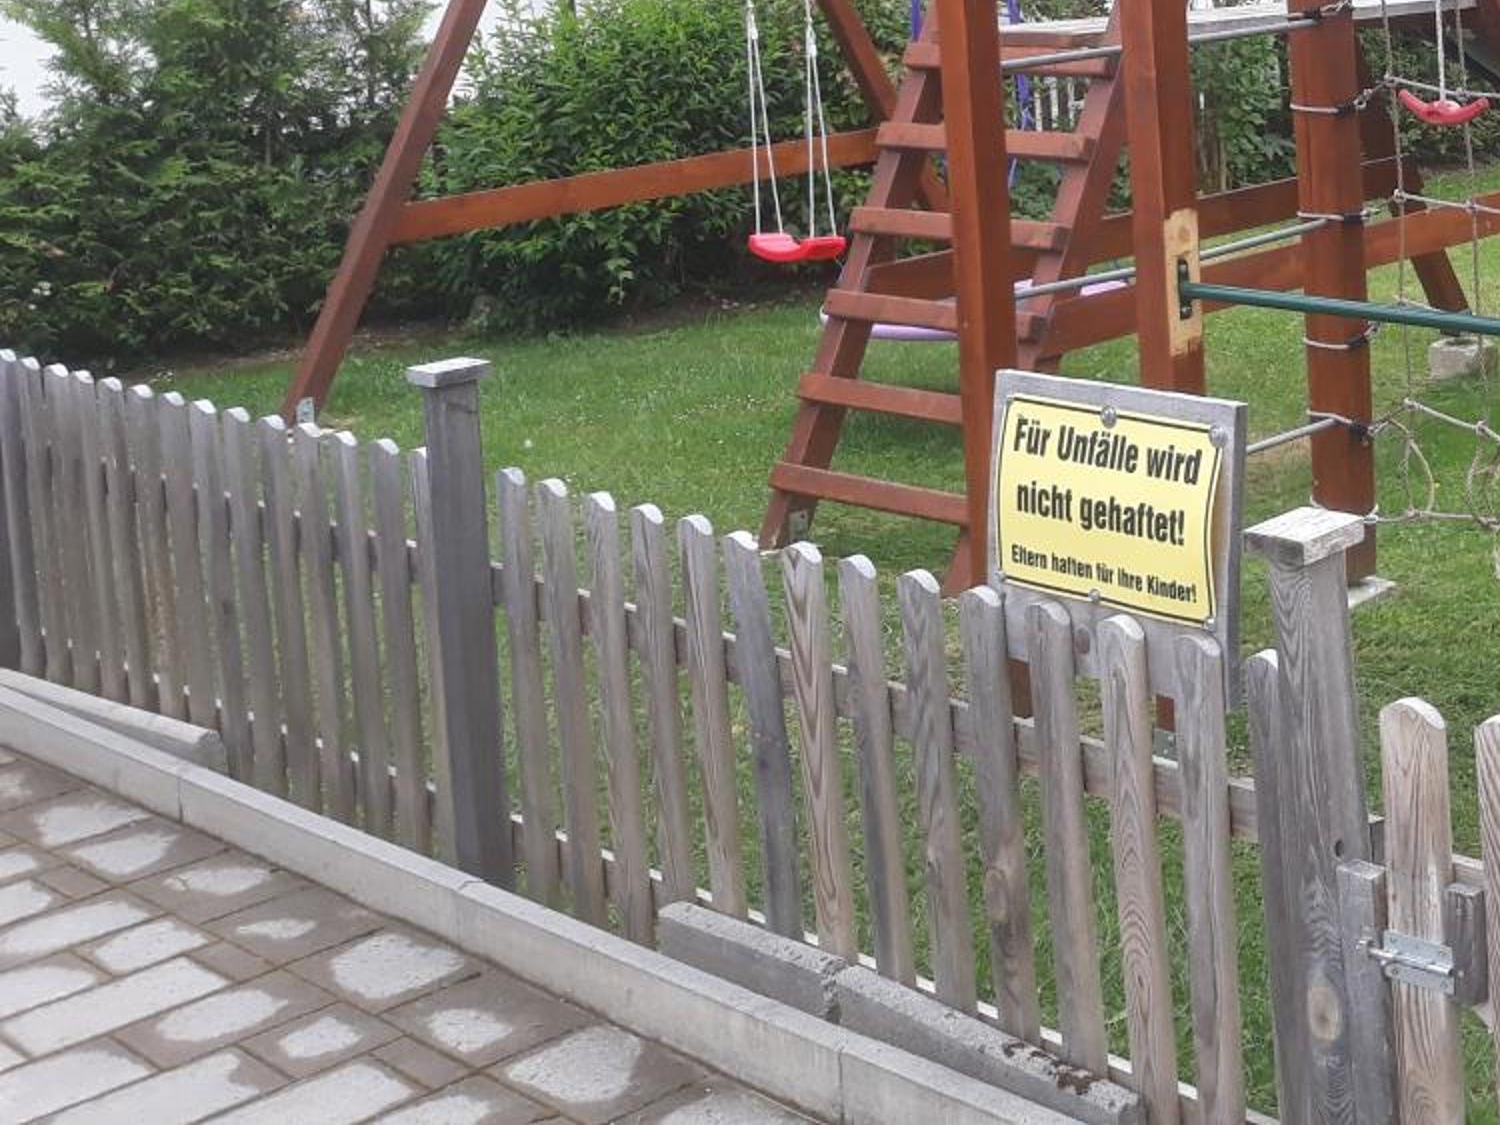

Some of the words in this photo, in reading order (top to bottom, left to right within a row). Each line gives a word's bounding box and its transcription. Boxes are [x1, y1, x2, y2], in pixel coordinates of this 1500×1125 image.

[1014, 417, 1051, 456] Für
[1057, 425, 1138, 474] Unfälle
[1147, 445, 1202, 485] wird
[1017, 481, 1072, 522] nicht
[1080, 496, 1185, 546] gehaftet!
[1011, 544, 1047, 569] Eltern
[1051, 552, 1093, 580] haften
[1096, 562, 1113, 584] für
[1147, 574, 1197, 603] Kinder!
